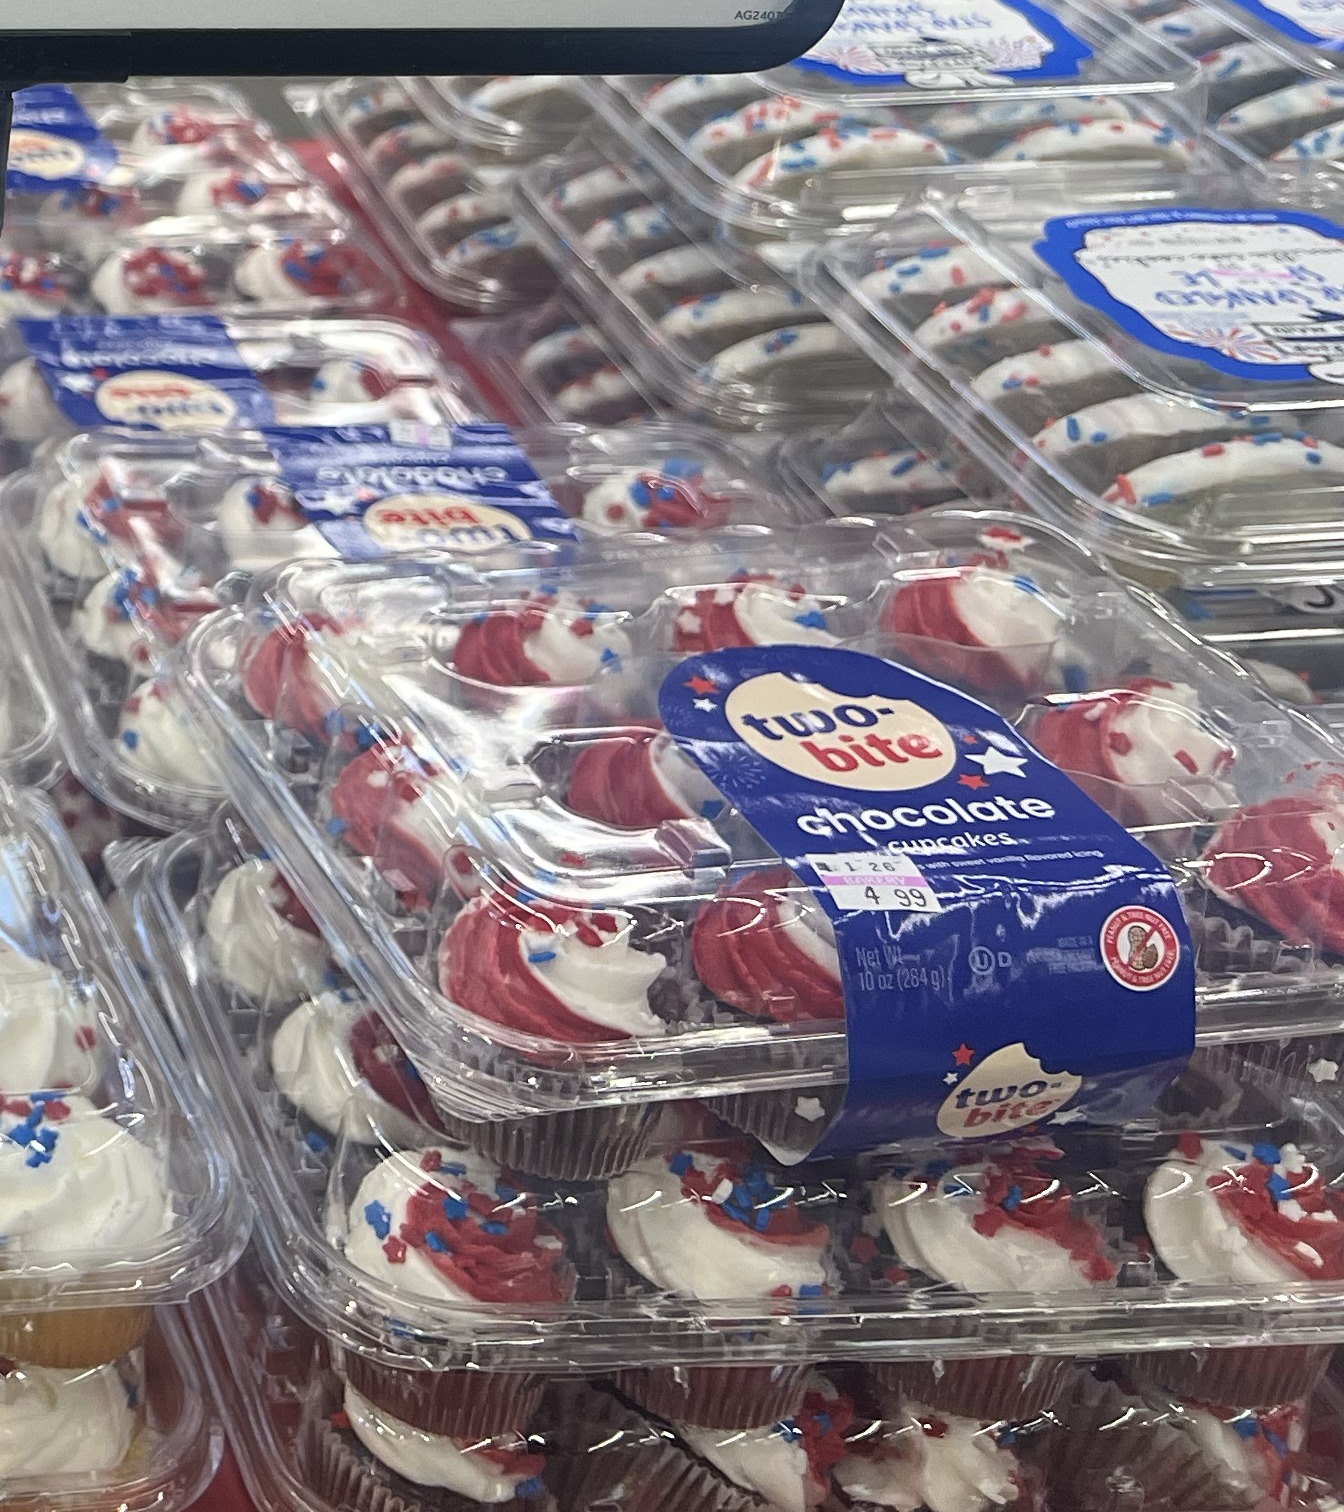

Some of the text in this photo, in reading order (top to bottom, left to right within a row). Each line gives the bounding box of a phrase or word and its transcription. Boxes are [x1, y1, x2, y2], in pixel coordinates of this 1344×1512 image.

[740, 703, 895, 741] two-
[799, 732, 943, 773] bite
[796, 795, 1056, 838] chocolate
[886, 829, 1015, 855] cupcakes
[842, 875, 907, 886] BAKERY
[855, 946, 882, 968] Net
[858, 964, 946, 991] 10 oz (264 g)
[955, 1080, 1063, 1109] two-
[963, 1100, 1053, 1128] bite
